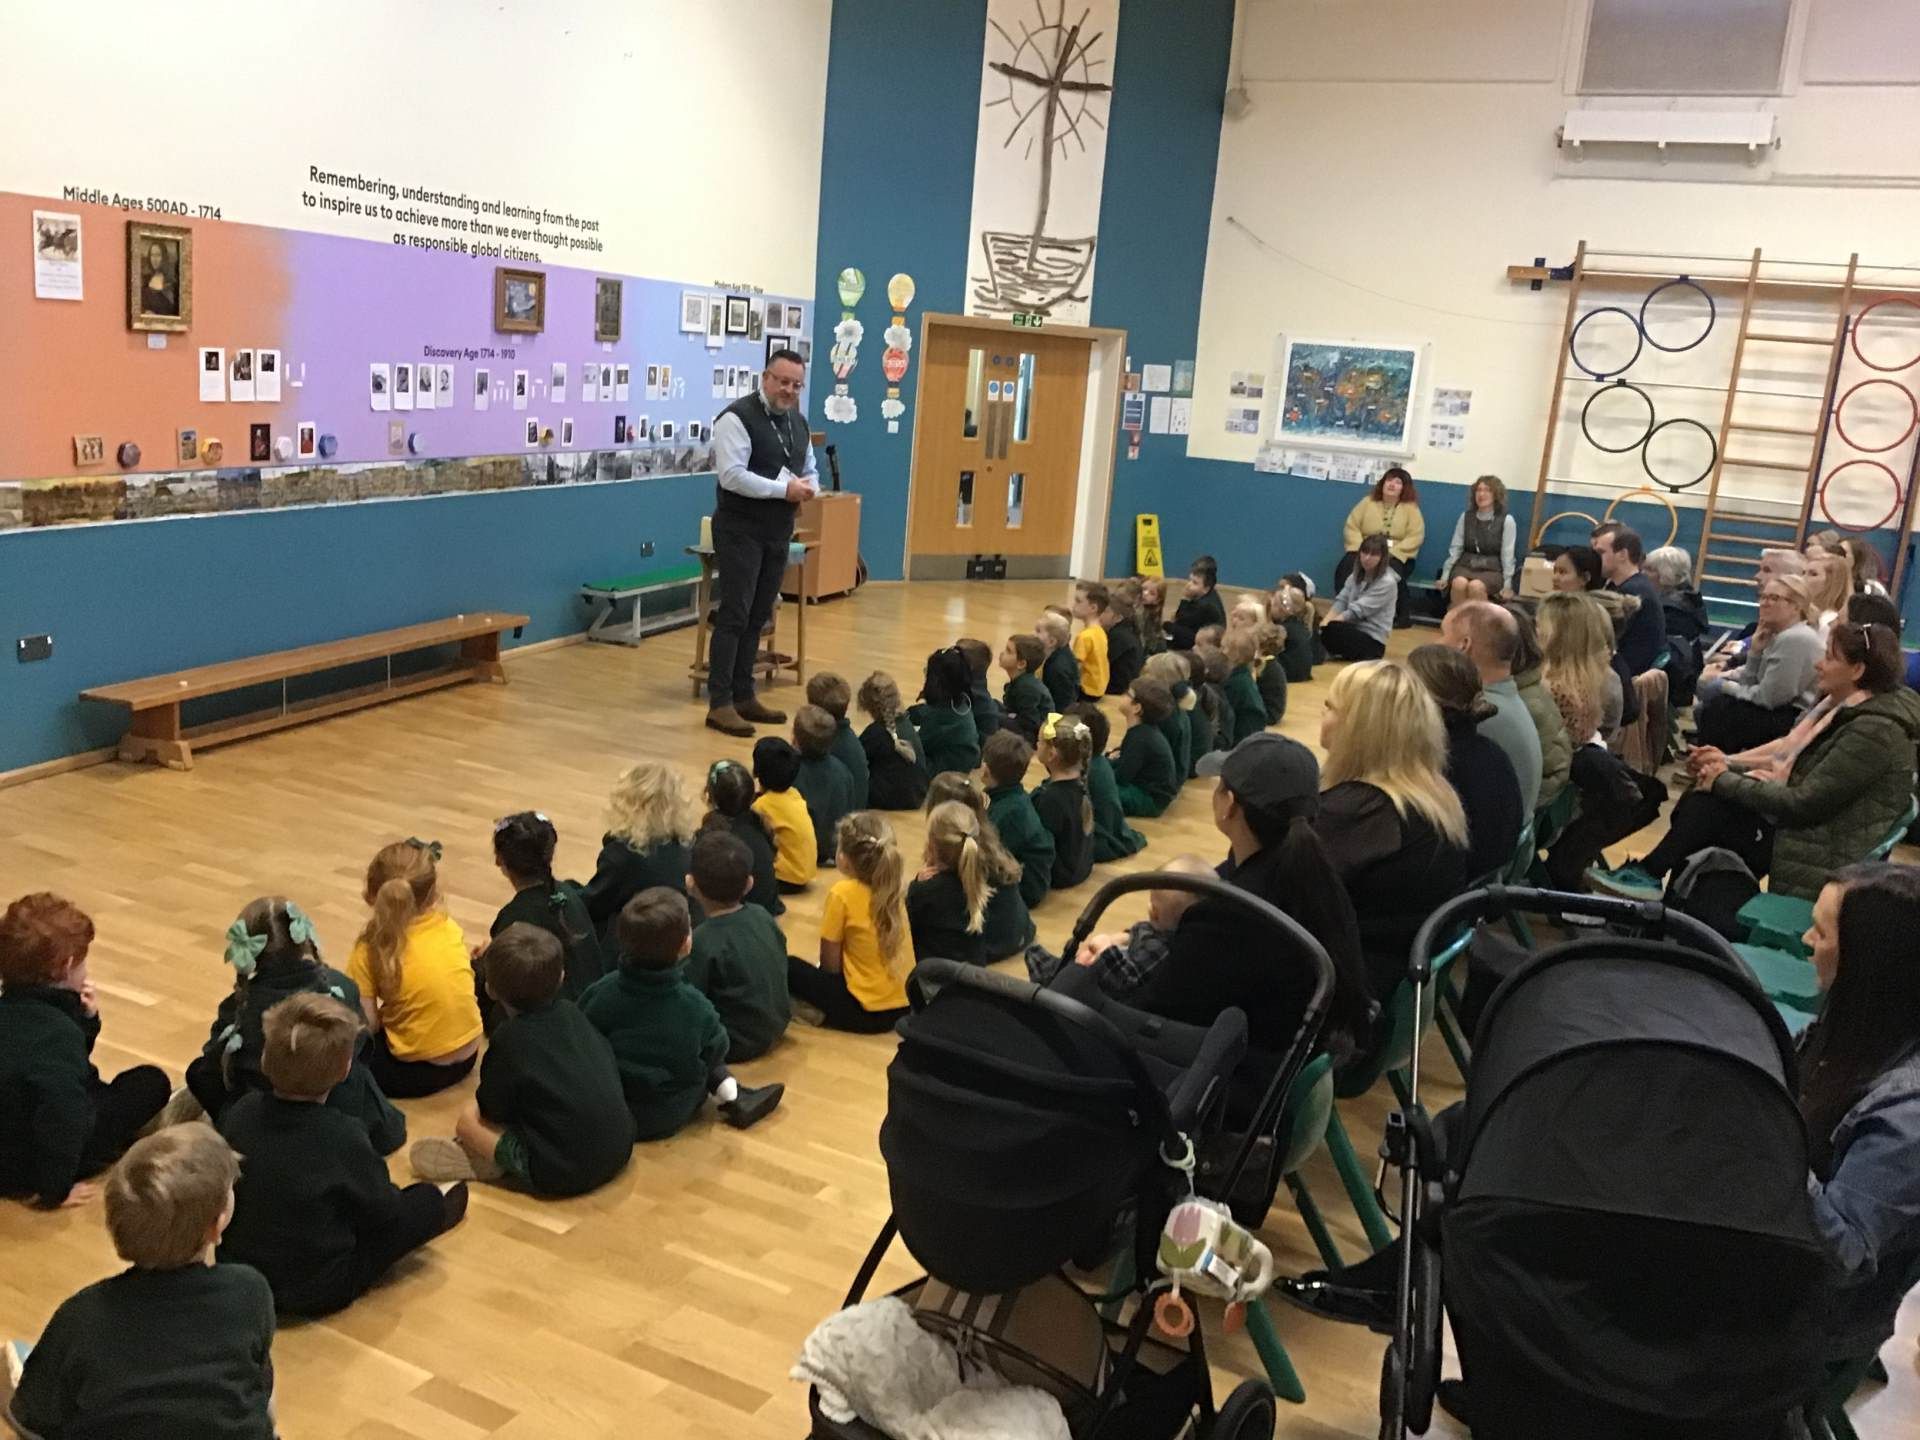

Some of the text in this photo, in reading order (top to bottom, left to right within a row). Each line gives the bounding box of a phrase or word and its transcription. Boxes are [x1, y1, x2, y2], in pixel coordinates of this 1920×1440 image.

[64, 186, 108, 205] Middle
[112, 193, 144, 212] Ages
[147, 198, 188, 215] 500AD
[198, 205, 222, 220] 1714
[310, 165, 599, 232] Remembering, understanding and learning from the past
[302, 191, 603, 252] to inspire us to achieve more than we ever thought possible
[393, 232, 542, 263] as responsible global citizens.
[424, 345, 462, 360] Discovery
[463, 347, 478, 360] Age
[480, 348, 495, 359] 1714
